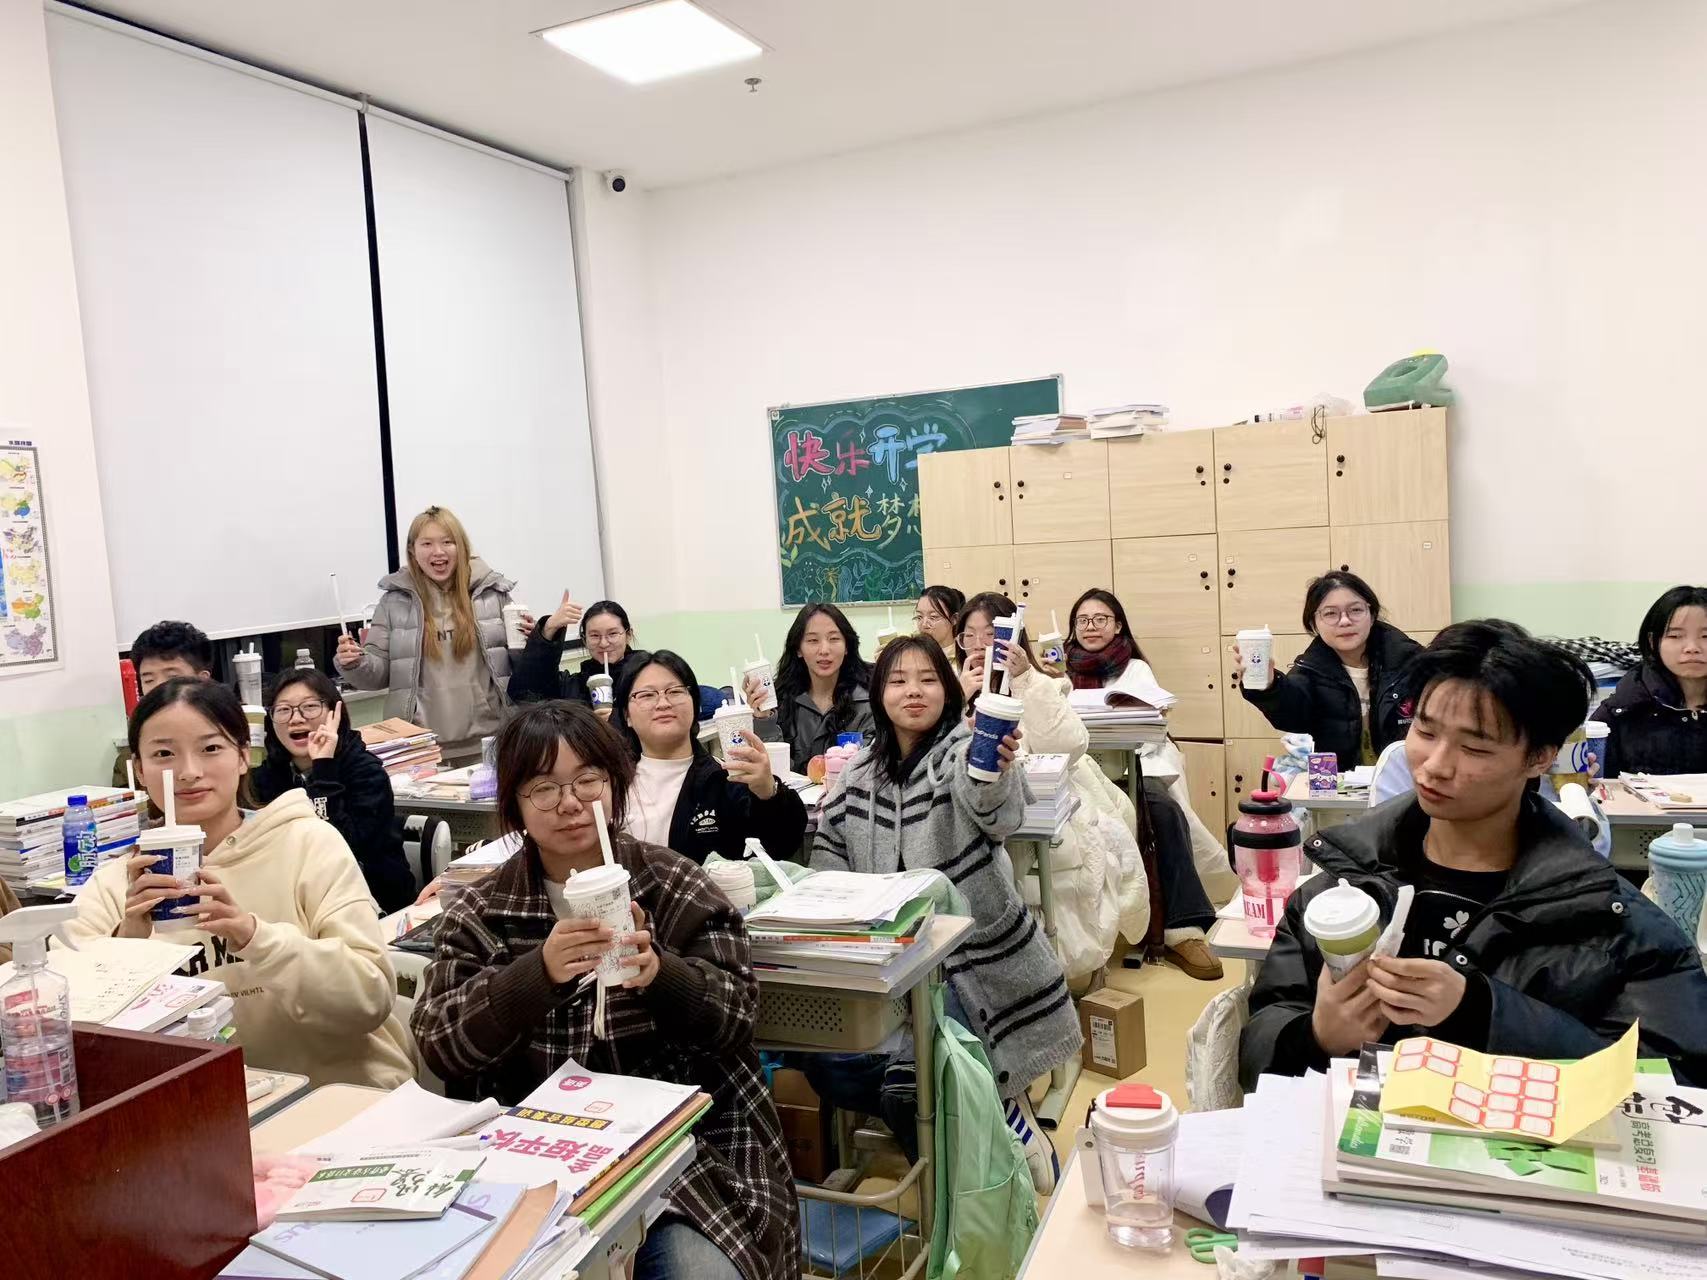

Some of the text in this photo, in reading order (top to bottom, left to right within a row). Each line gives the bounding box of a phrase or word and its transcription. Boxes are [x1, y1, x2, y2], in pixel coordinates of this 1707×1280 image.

[784, 421, 946, 484] 快乐开学
[1630, 1120, 1657, 1165] 高考总复习
